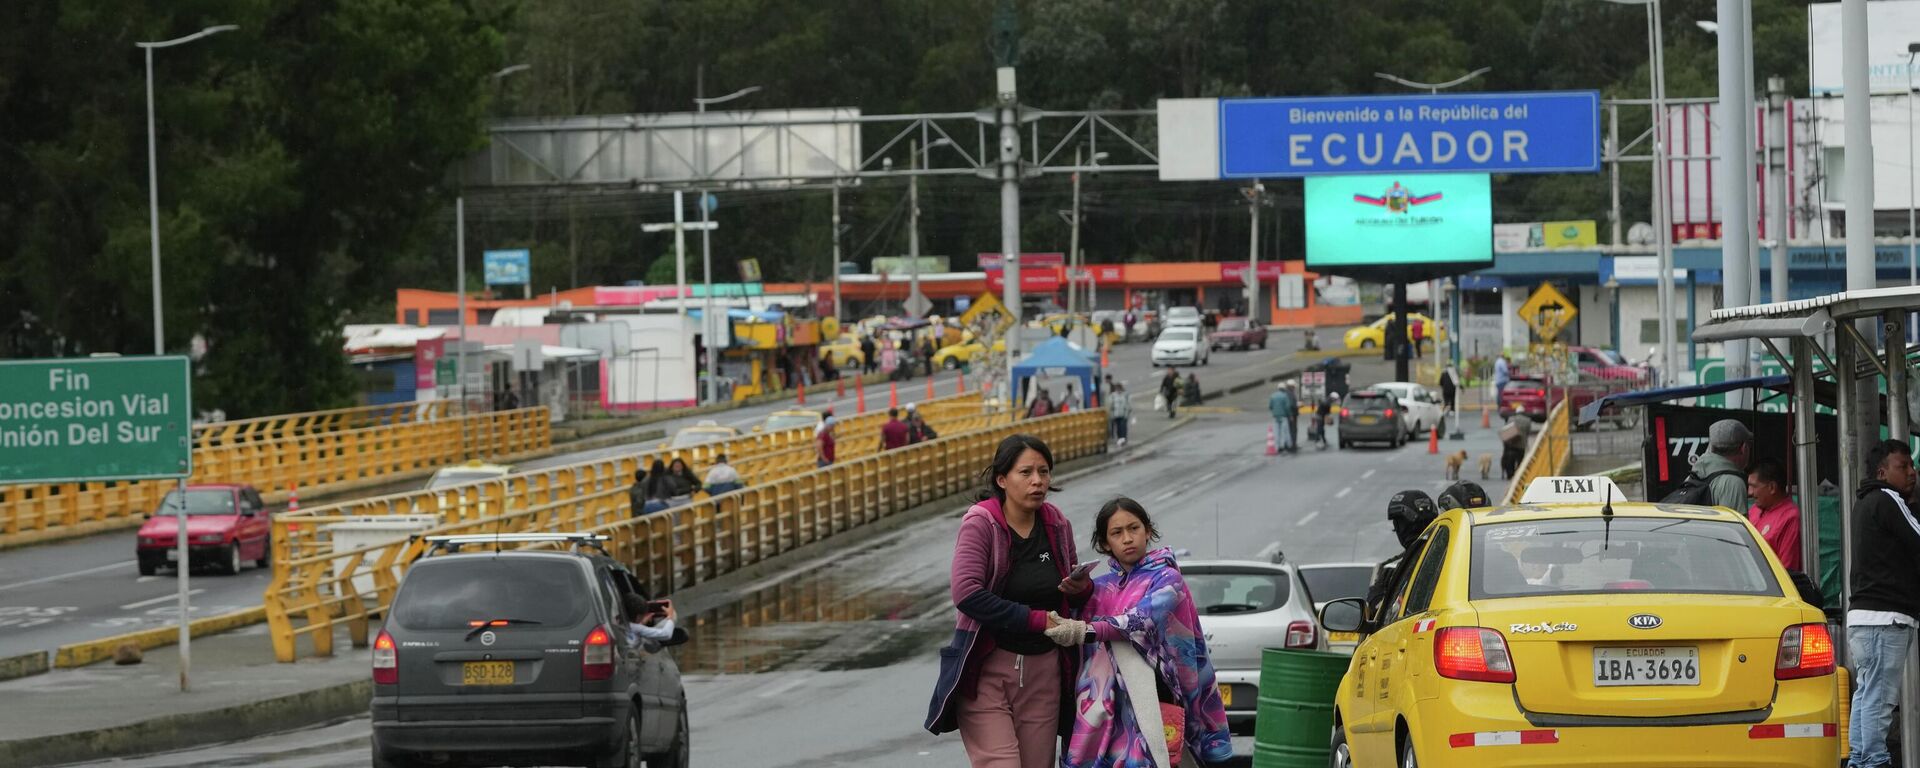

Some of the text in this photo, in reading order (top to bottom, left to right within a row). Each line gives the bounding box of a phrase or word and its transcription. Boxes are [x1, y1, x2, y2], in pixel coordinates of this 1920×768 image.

[1289, 104, 1528, 124] Bienvenido a la República del
[1289, 130, 1529, 166] ECUADOR
[49, 368, 90, 391] Fin
[0, 393, 169, 420] oncesion Vial
[0, 421, 161, 448] nión Del Sur
[1551, 479, 1594, 494] TAXI
[1626, 648, 1666, 657] ECUADOR
